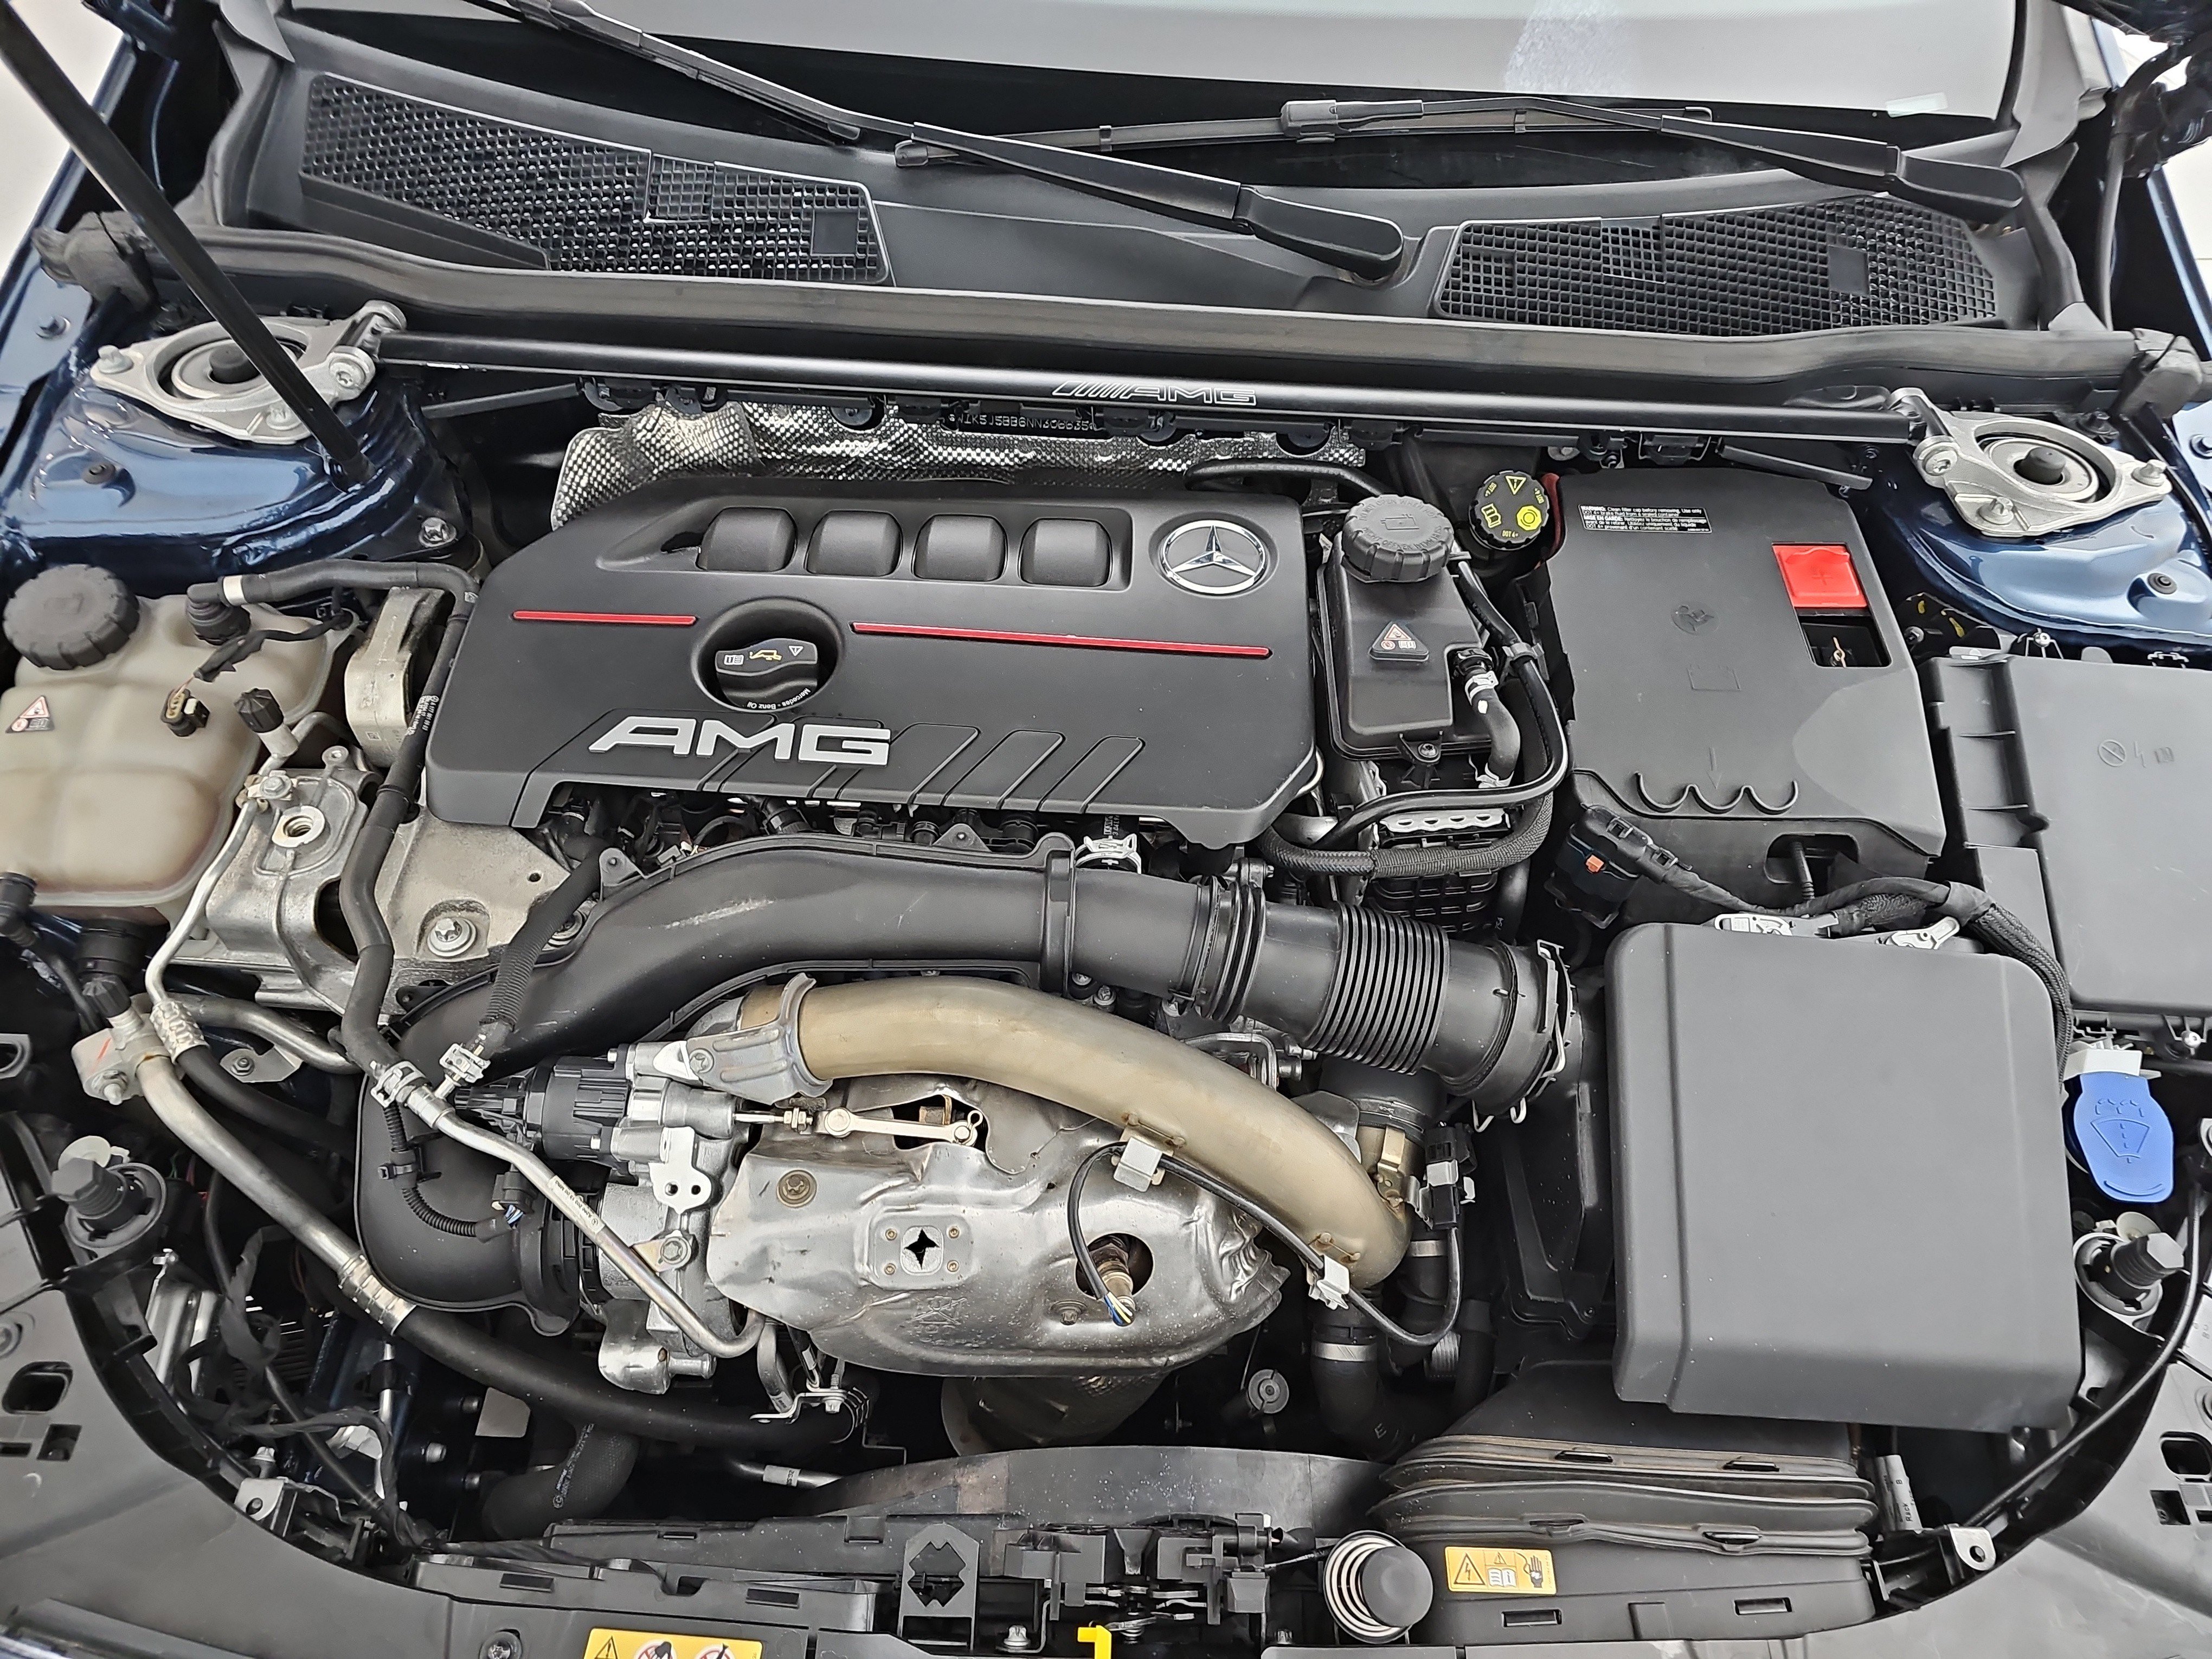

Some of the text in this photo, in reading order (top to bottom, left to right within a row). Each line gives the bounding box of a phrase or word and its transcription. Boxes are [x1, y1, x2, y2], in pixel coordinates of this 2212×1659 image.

[1119, 383, 1256, 406] AMG
[747, 701, 757, 709] Oil
[781, 687, 811, 706] Mercedes
[588, 716, 891, 767] AMG
